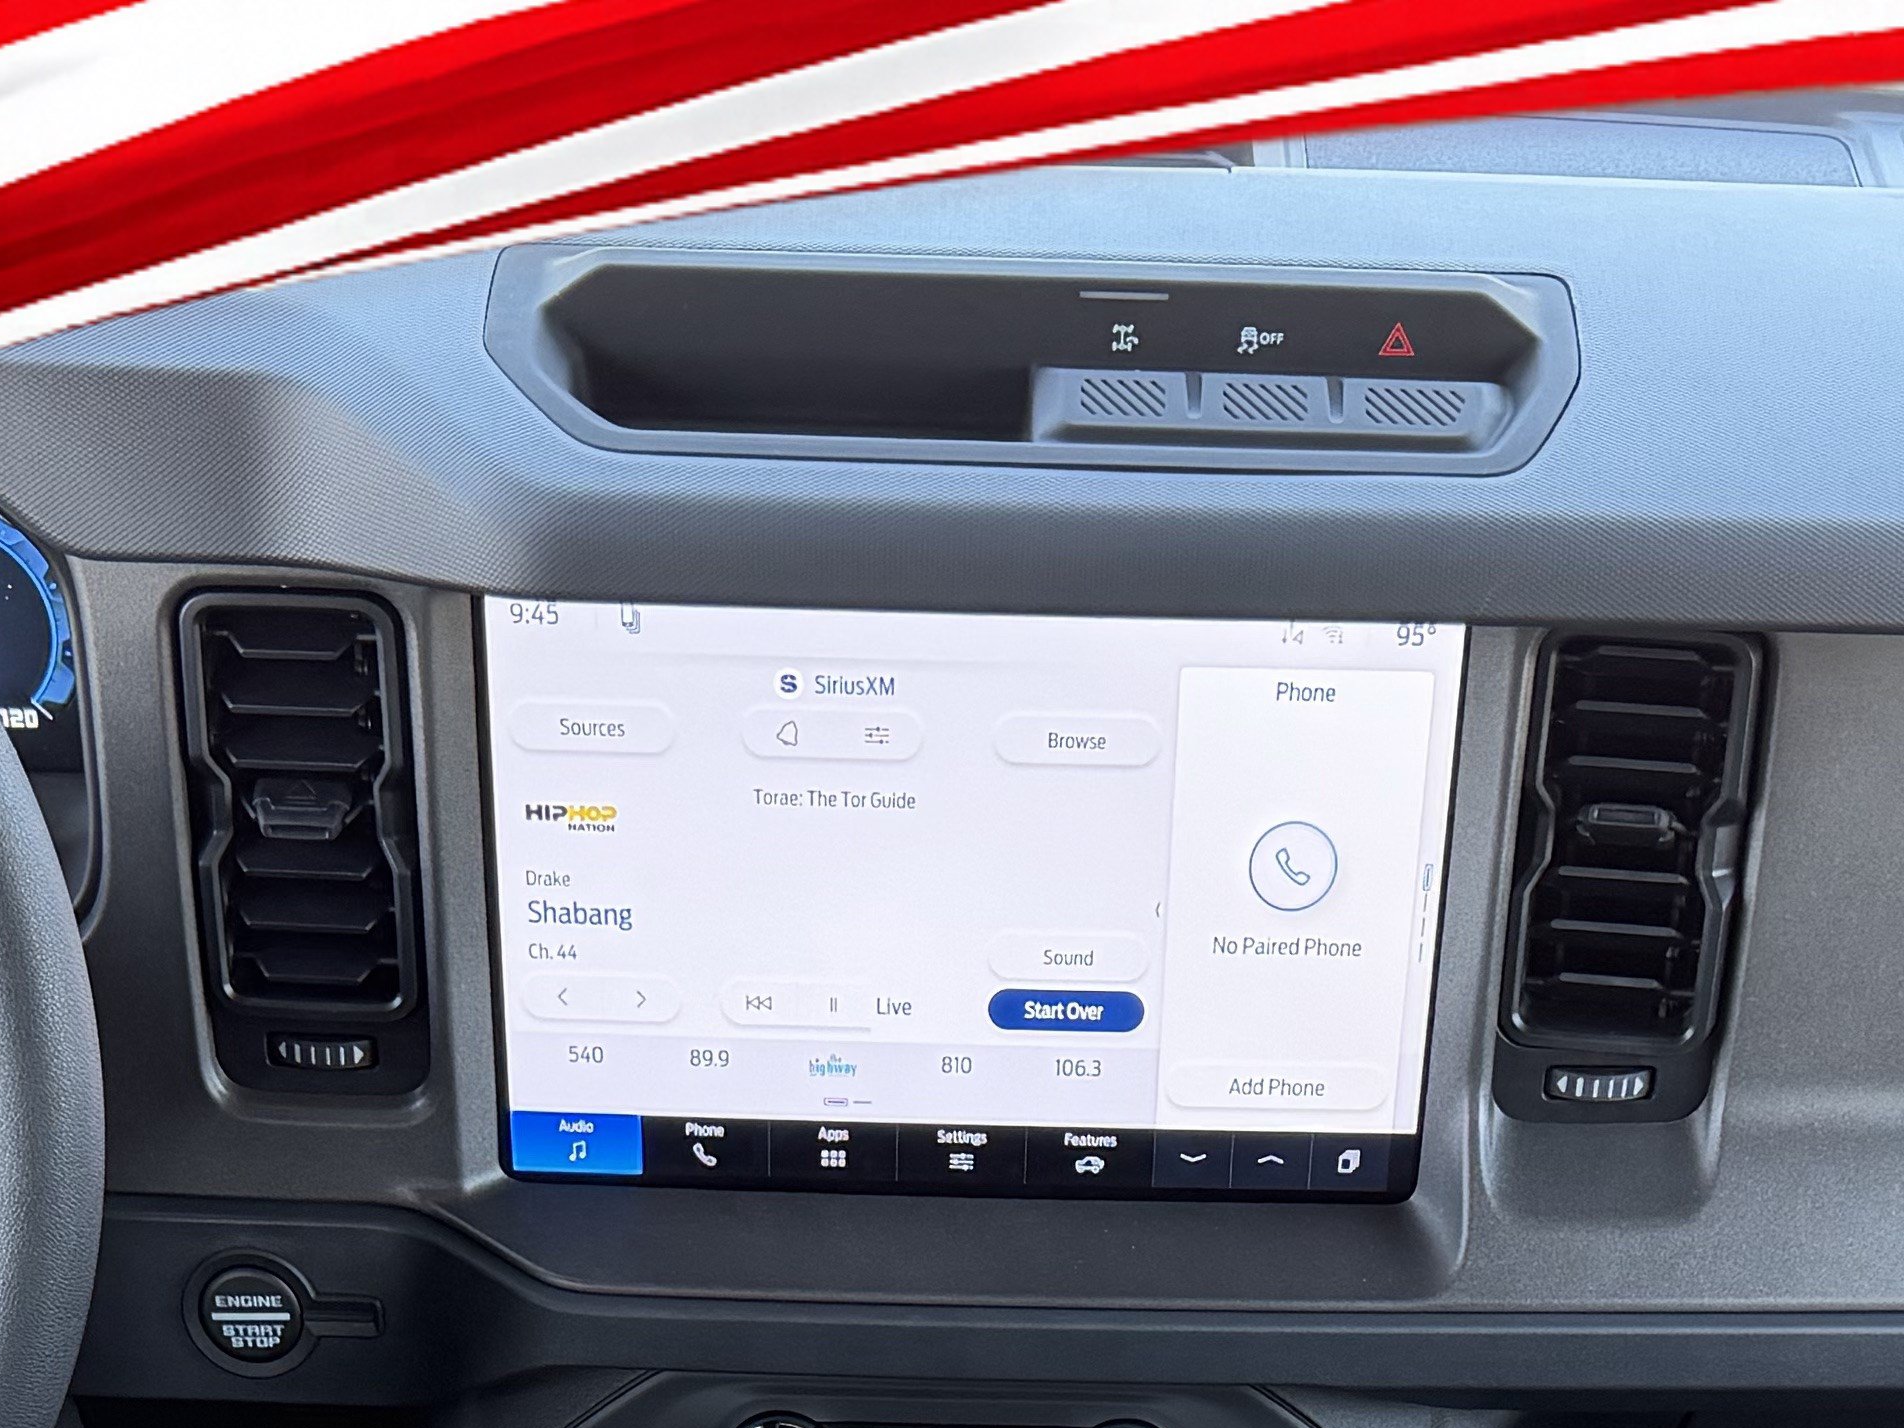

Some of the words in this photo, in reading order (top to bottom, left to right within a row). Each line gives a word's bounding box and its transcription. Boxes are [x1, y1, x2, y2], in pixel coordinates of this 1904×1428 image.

[1259, 332, 1284, 345] OFF
[509, 603, 559, 626] 9:45
[814, 674, 895, 696] SiriusXM
[1276, 682, 1336, 703] Phone
[0, 707, 39, 729] 120
[559, 718, 626, 738] Sources
[1047, 732, 1107, 751] Browse
[753, 788, 803, 808] Torae:
[807, 790, 837, 808] The
[840, 790, 867, 808] Tor
[870, 791, 916, 810] Guide
[568, 823, 615, 832] NATION
[525, 870, 571, 887] Drake
[528, 900, 633, 931] Shabang
[528, 943, 553, 960] Ch.
[556, 944, 578, 960] 44
[1212, 937, 1238, 956] No
[1242, 937, 1300, 957] Paired
[1305, 938, 1362, 957] Phone
[1043, 949, 1094, 967] Sound
[876, 997, 912, 1016] Live
[1024, 1001, 1064, 1020] Start
[1066, 1002, 1104, 1021] Over
[568, 1046, 604, 1064] 540
[690, 1049, 730, 1067] 89.9
[809, 1058, 857, 1077] highway
[941, 1056, 972, 1075] 810
[1055, 1058, 1102, 1077] 106.3
[1228, 1078, 1264, 1097] Add
[1268, 1078, 1325, 1097] Phone
[559, 1118, 594, 1134] Audio
[685, 1122, 724, 1138] Phone
[817, 1126, 849, 1142] Apps
[937, 1130, 987, 1147] Settings
[1064, 1132, 1117, 1149] Features
[215, 1295, 283, 1307] ENGINE
[222, 1325, 284, 1337] START
[231, 1336, 281, 1348] STOP
